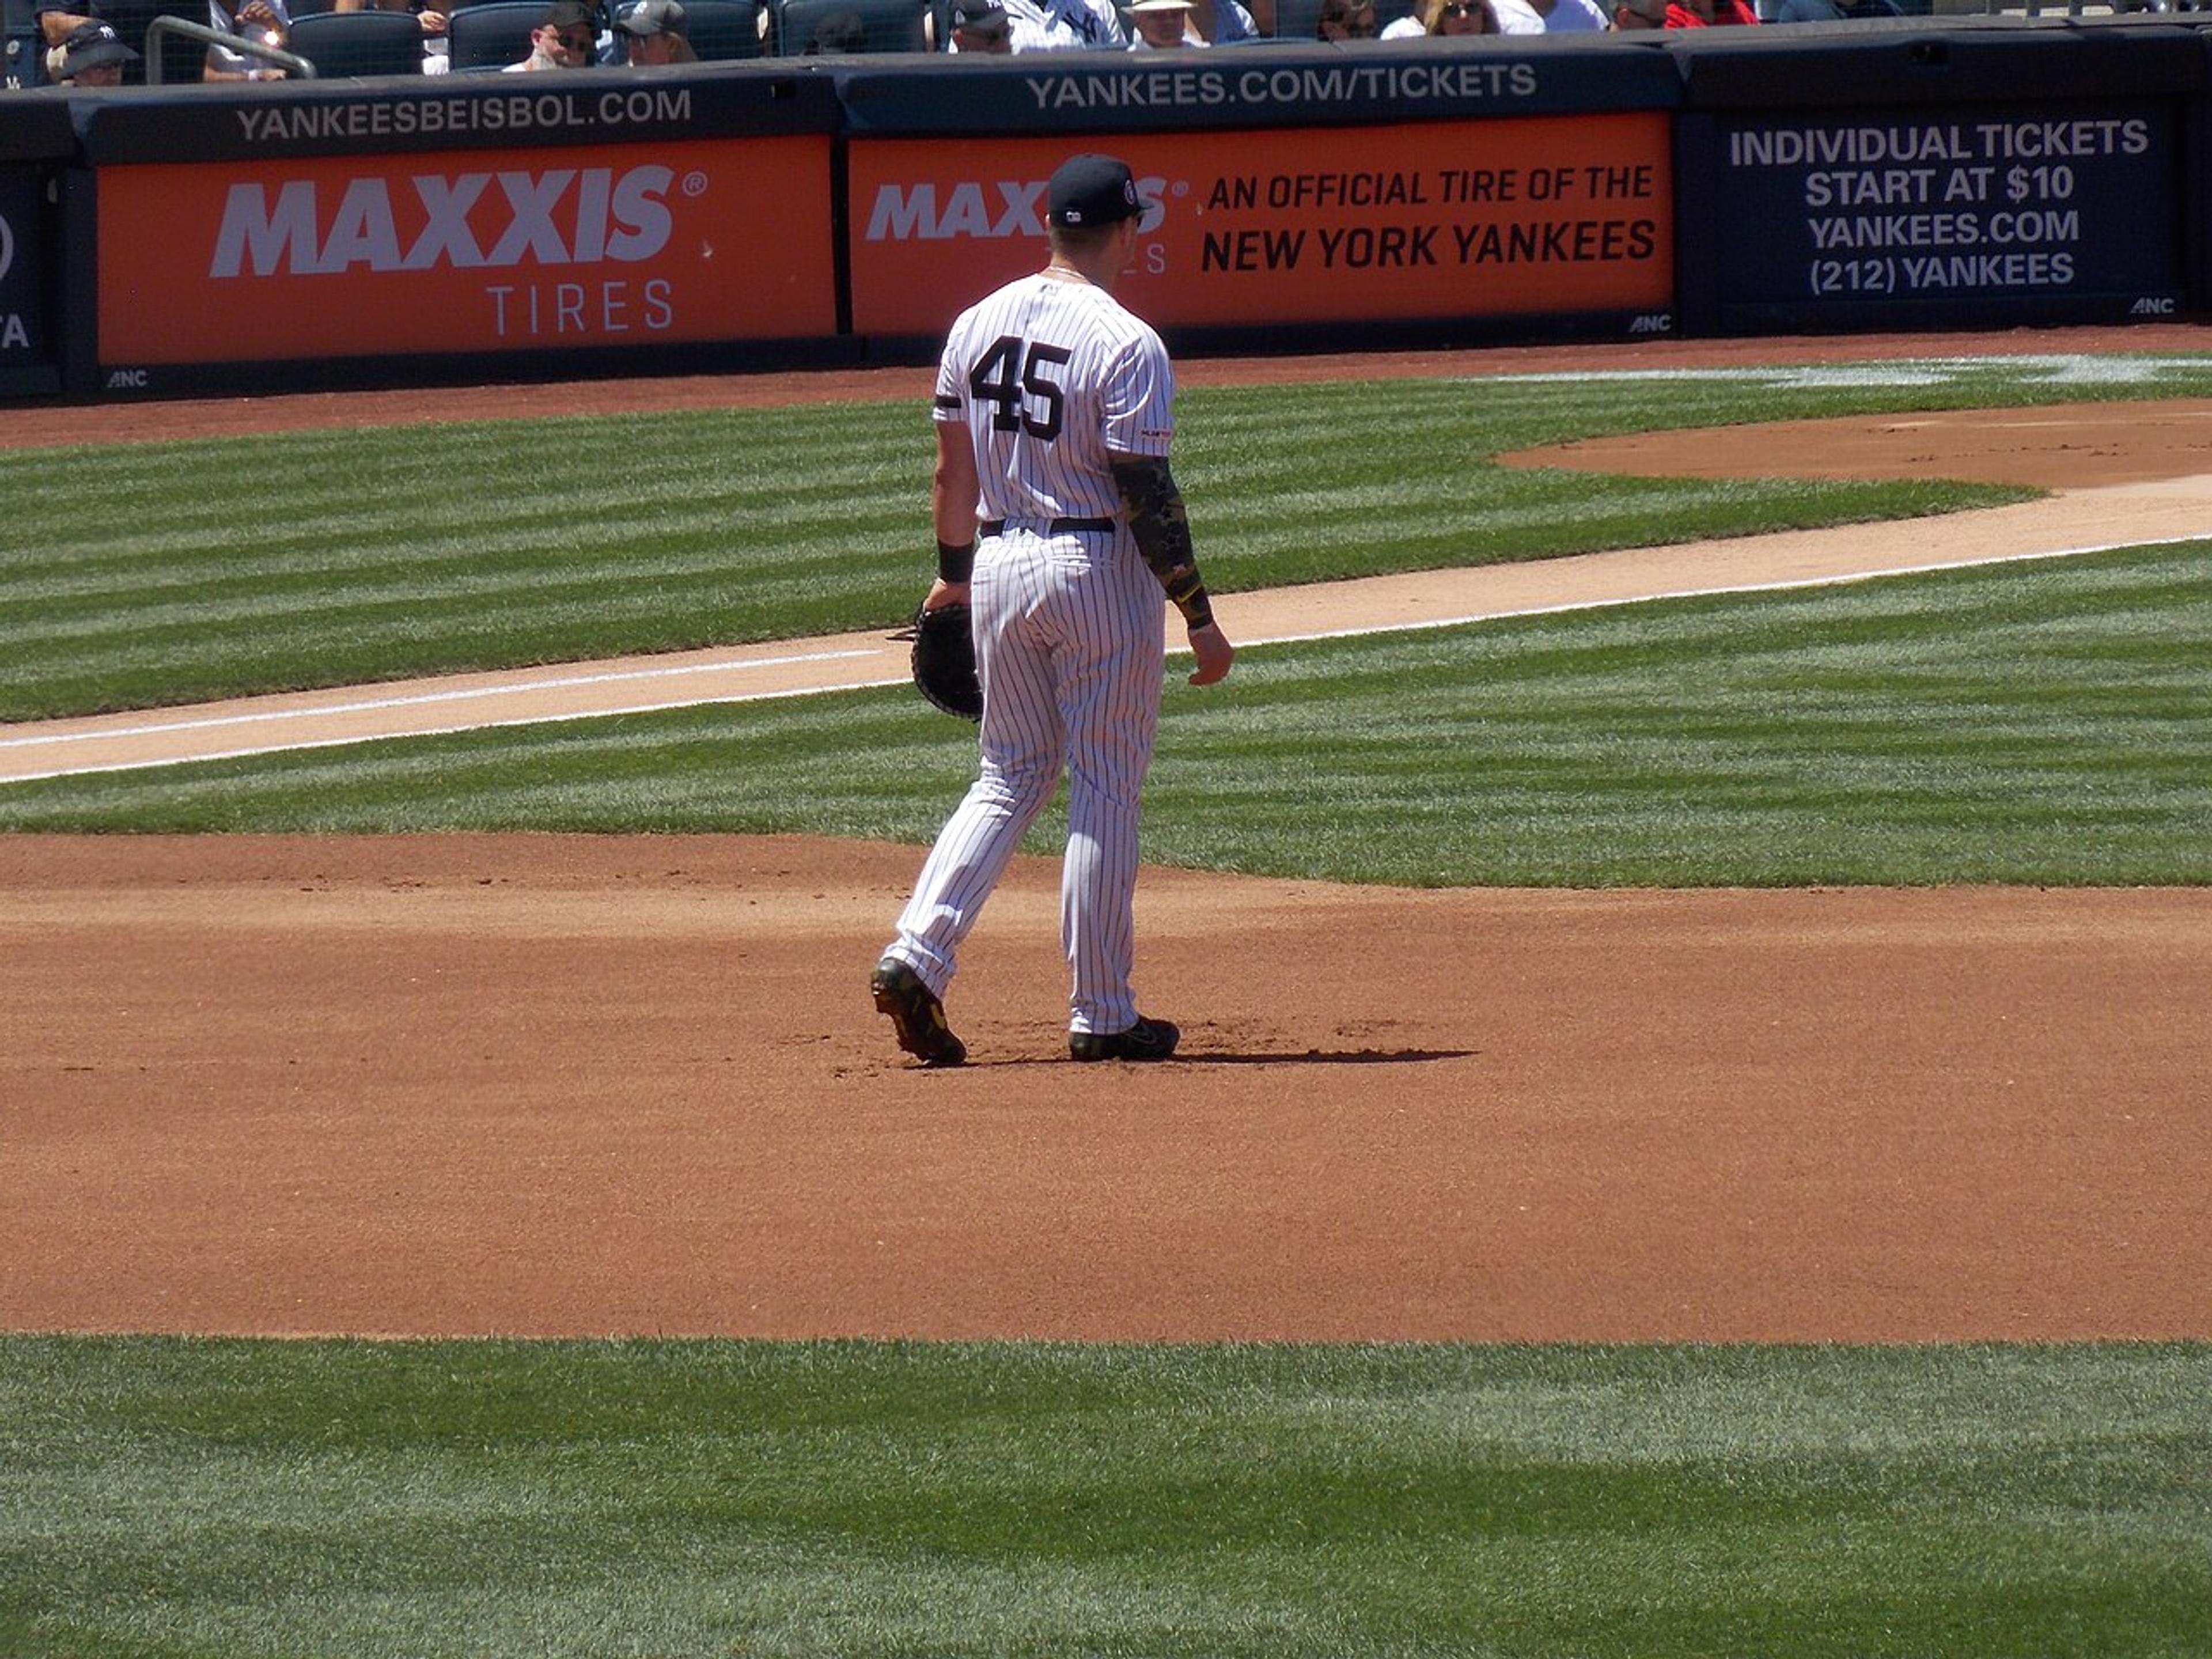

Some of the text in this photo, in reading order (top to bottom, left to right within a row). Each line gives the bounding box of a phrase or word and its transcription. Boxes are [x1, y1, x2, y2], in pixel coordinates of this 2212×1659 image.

[1025, 63, 1537, 109] YANKEES.COM/TICKETS
[236, 89, 691, 141] YANKEESBEISBOL.COM
[1730, 119, 2149, 166] INDIVIDUAL TICKETS
[866, 177, 1167, 240] MAXS
[1208, 165, 1653, 210] AN OFFICIAL TIRE OF THE
[1805, 164, 2074, 206] START AT $10
[1202, 229, 1306, 271] NEW
[1318, 225, 1439, 268] YORK
[1453, 219, 1656, 264] YANKEES
[1808, 210, 2079, 248] YANKEES.COM
[1810, 252, 2075, 296] (212) YANKEES
[486, 279, 673, 336] TIRES
[969, 335, 1072, 442] 45
